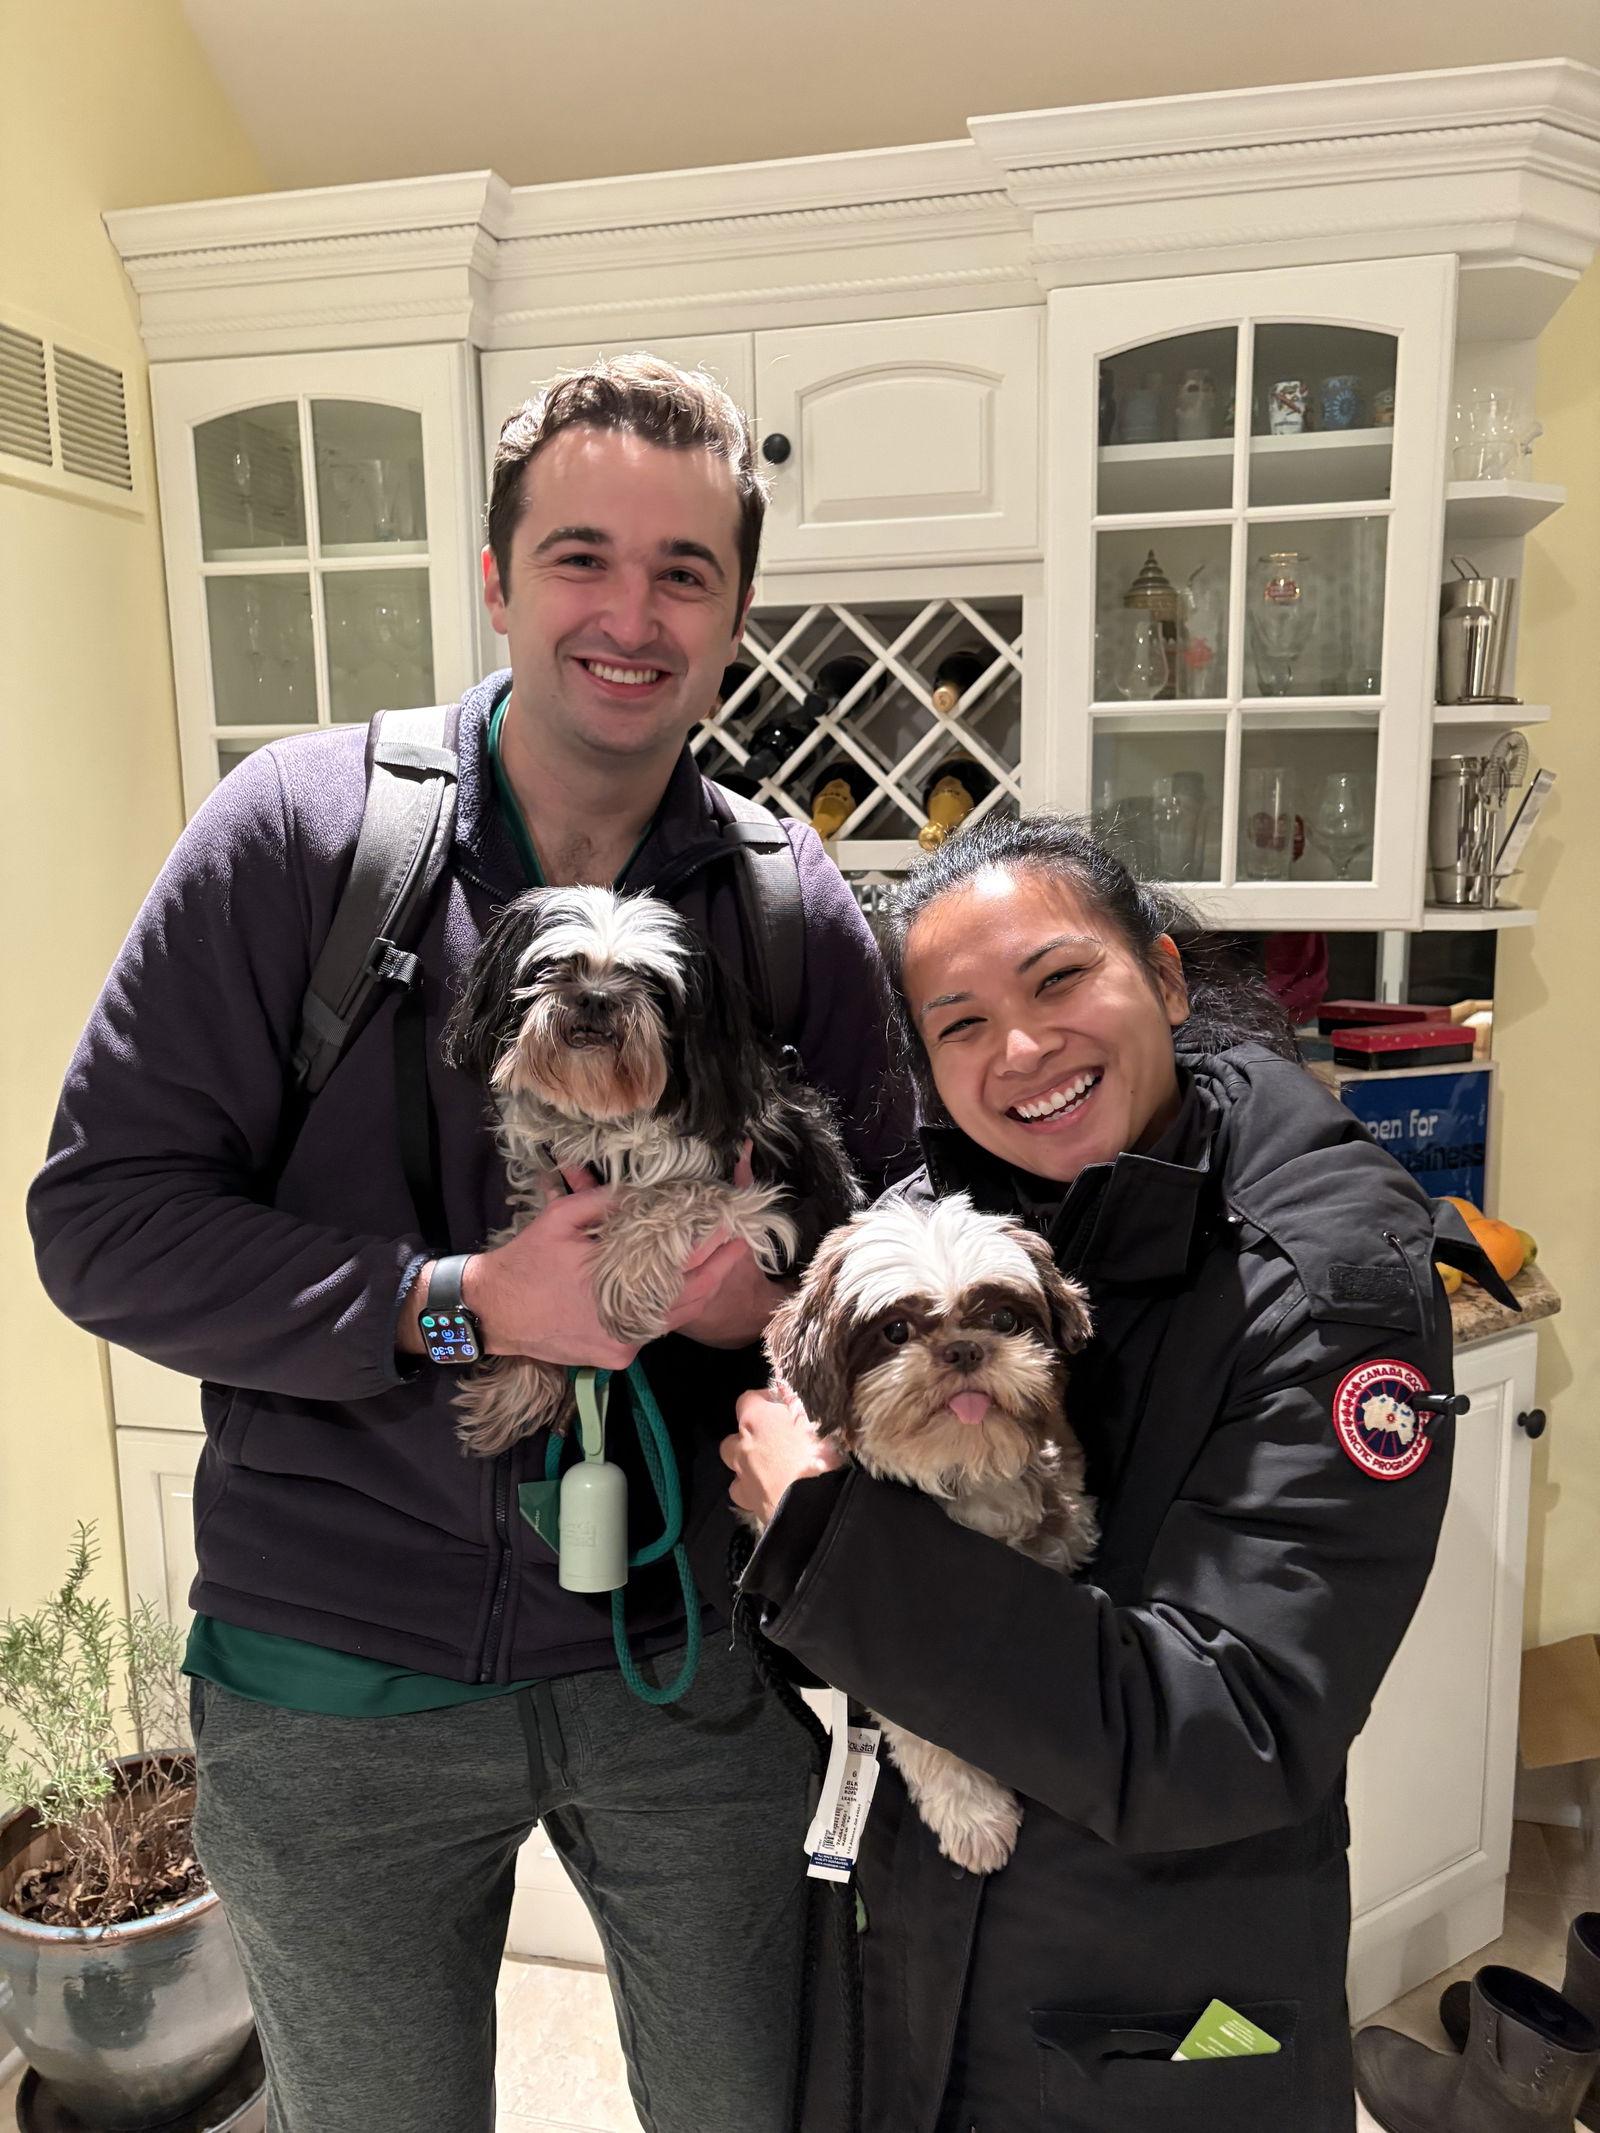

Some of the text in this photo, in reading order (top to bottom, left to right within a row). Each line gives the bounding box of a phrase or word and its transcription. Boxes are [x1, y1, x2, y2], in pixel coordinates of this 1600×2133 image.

[1409, 1109, 1439, 1138] for
[1386, 1142, 1486, 1171] siness
[1359, 1367, 1421, 1392] CANADA GOO
[1344, 1428, 1414, 1471] ARCTIC PROGRAM
[848, 1741, 875, 1752] oastal
